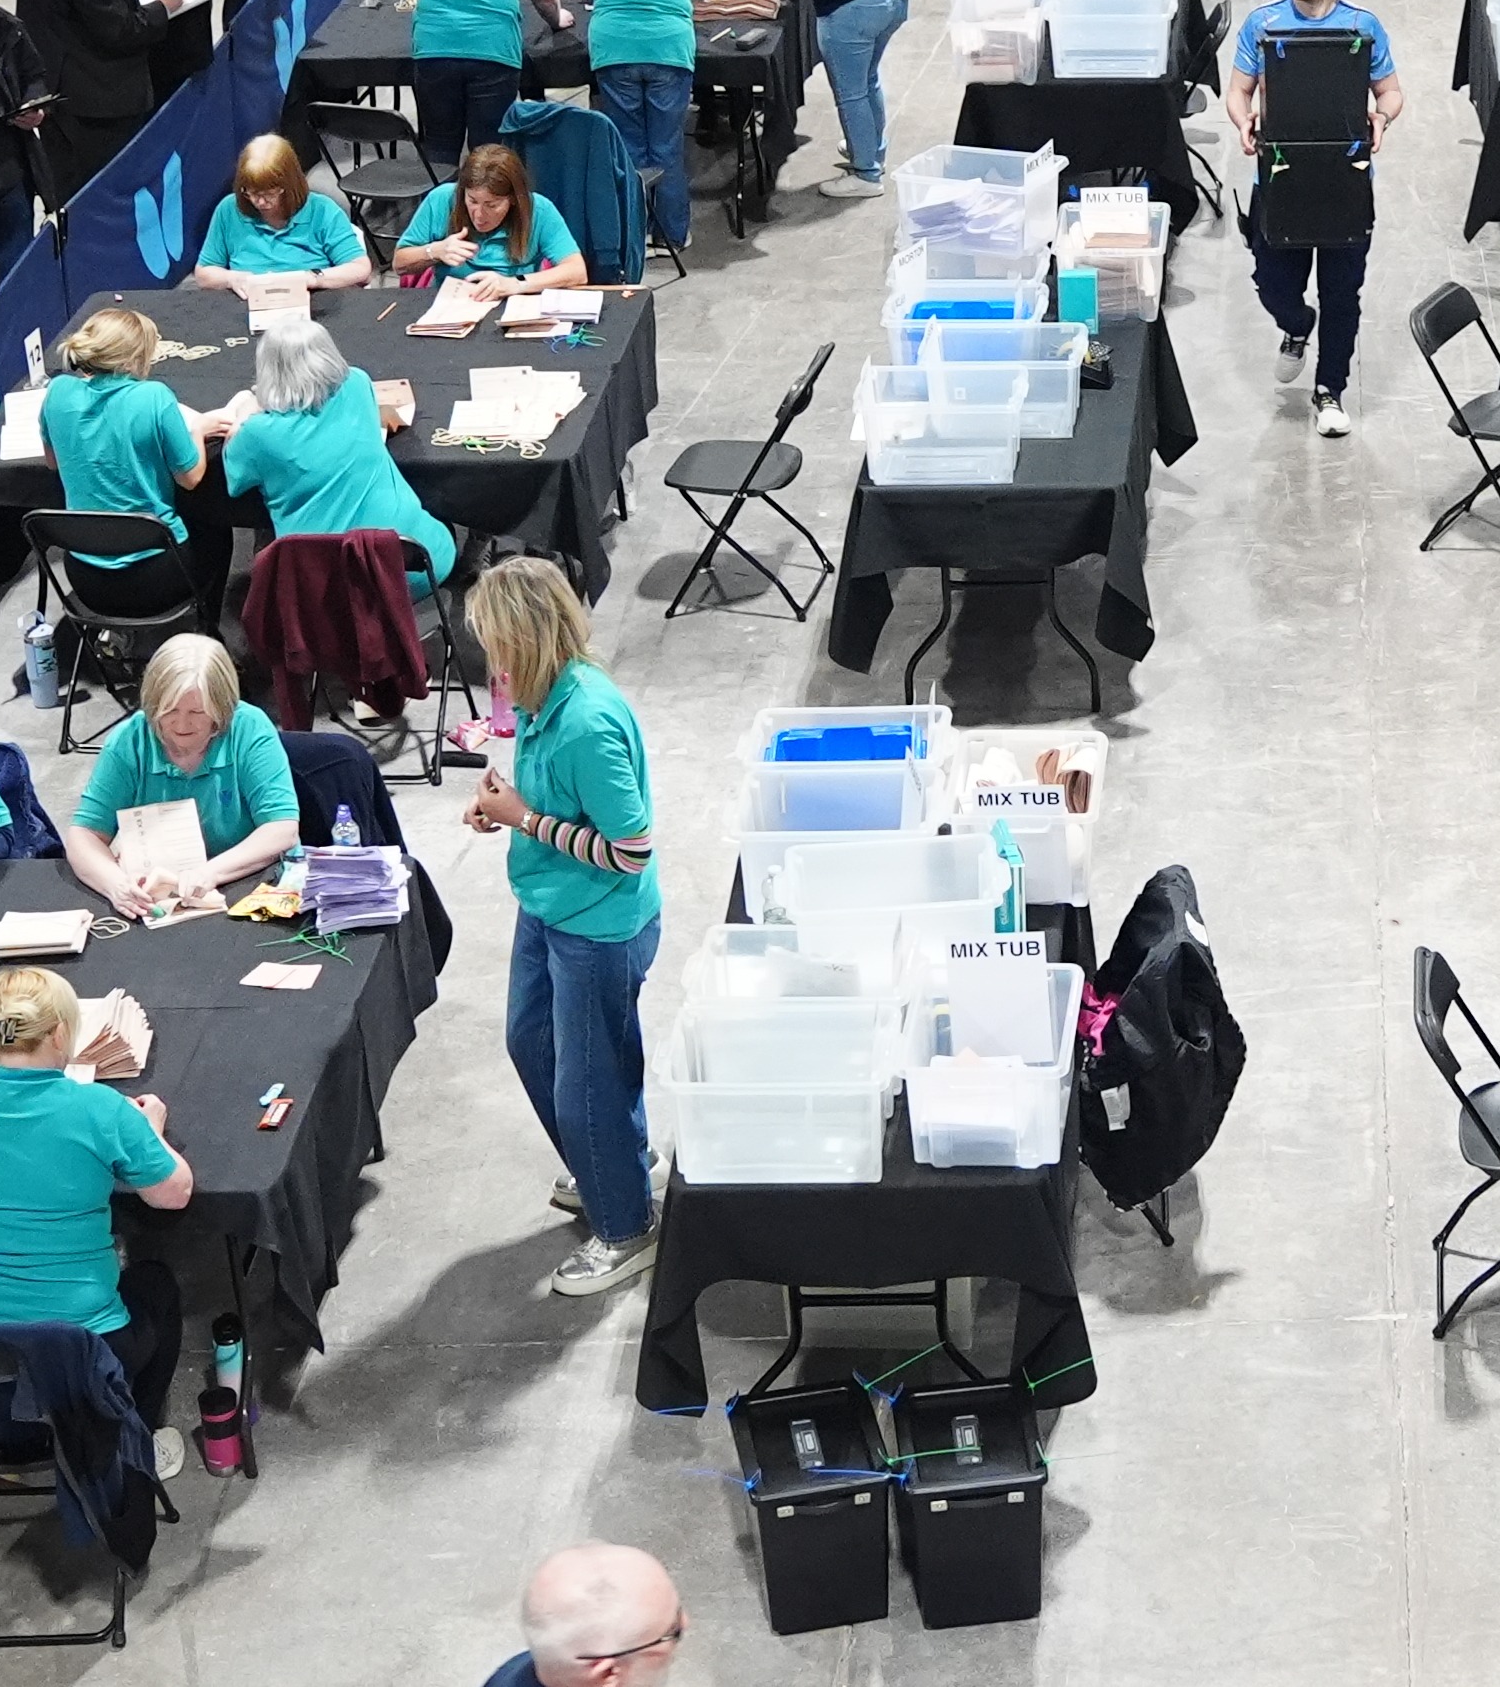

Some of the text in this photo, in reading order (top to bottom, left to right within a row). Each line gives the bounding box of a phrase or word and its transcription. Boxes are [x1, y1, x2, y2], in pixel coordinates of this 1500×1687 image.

[1026, 145, 1053, 171] MIX TUB
[1085, 192, 1144, 203] MIX TUB
[29, 344, 42, 368] 12
[978, 792, 1060, 807] MIX TUB
[951, 940, 1041, 958] MIX TUB
